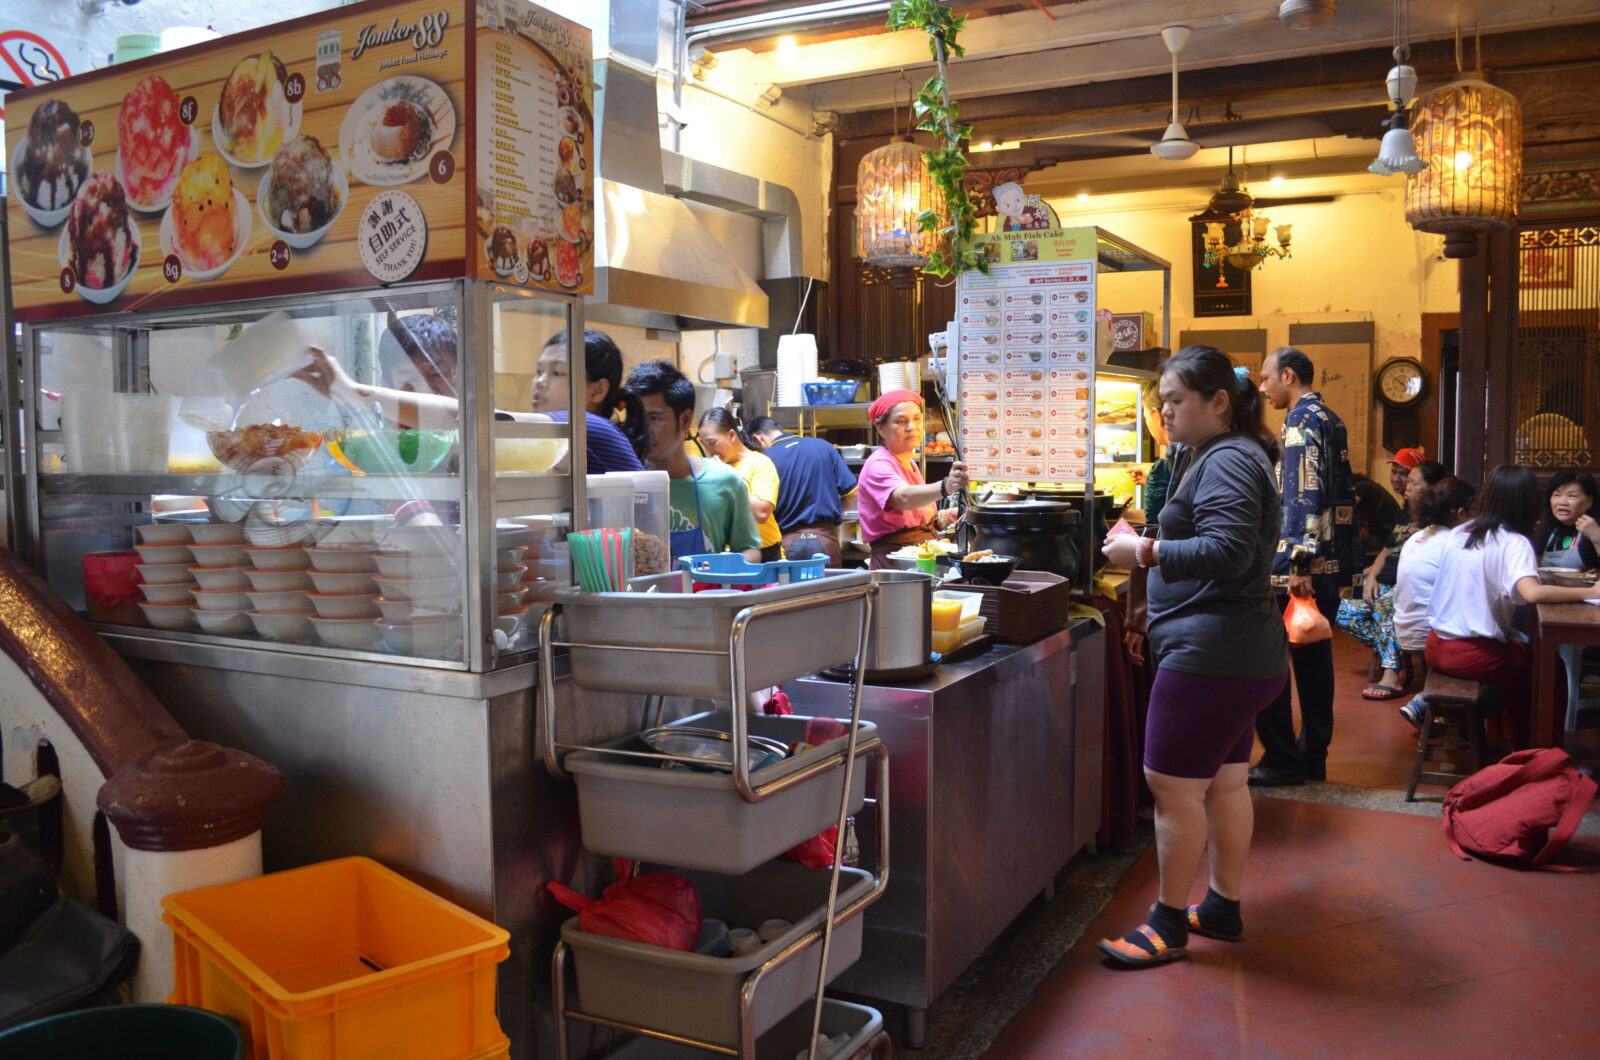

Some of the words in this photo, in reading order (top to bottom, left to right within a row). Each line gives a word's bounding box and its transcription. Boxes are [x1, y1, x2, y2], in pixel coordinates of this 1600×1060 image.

[317, 62, 342, 92] 88
[287, 78, 302, 97] 8b
[182, 101, 194, 121] 8f
[438, 159, 446, 175] 6
[368, 206, 411, 255] 自助式
[1003, 232, 1021, 241] Mah
[1024, 231, 1042, 240] Fish
[1043, 230, 1065, 239] Cake
[375, 249, 389, 266] SELF
[389, 224, 417, 254] SERVICE
[383, 257, 408, 272] THANK
[406, 240, 417, 258] YOU
[64, 274, 71, 288] 8
